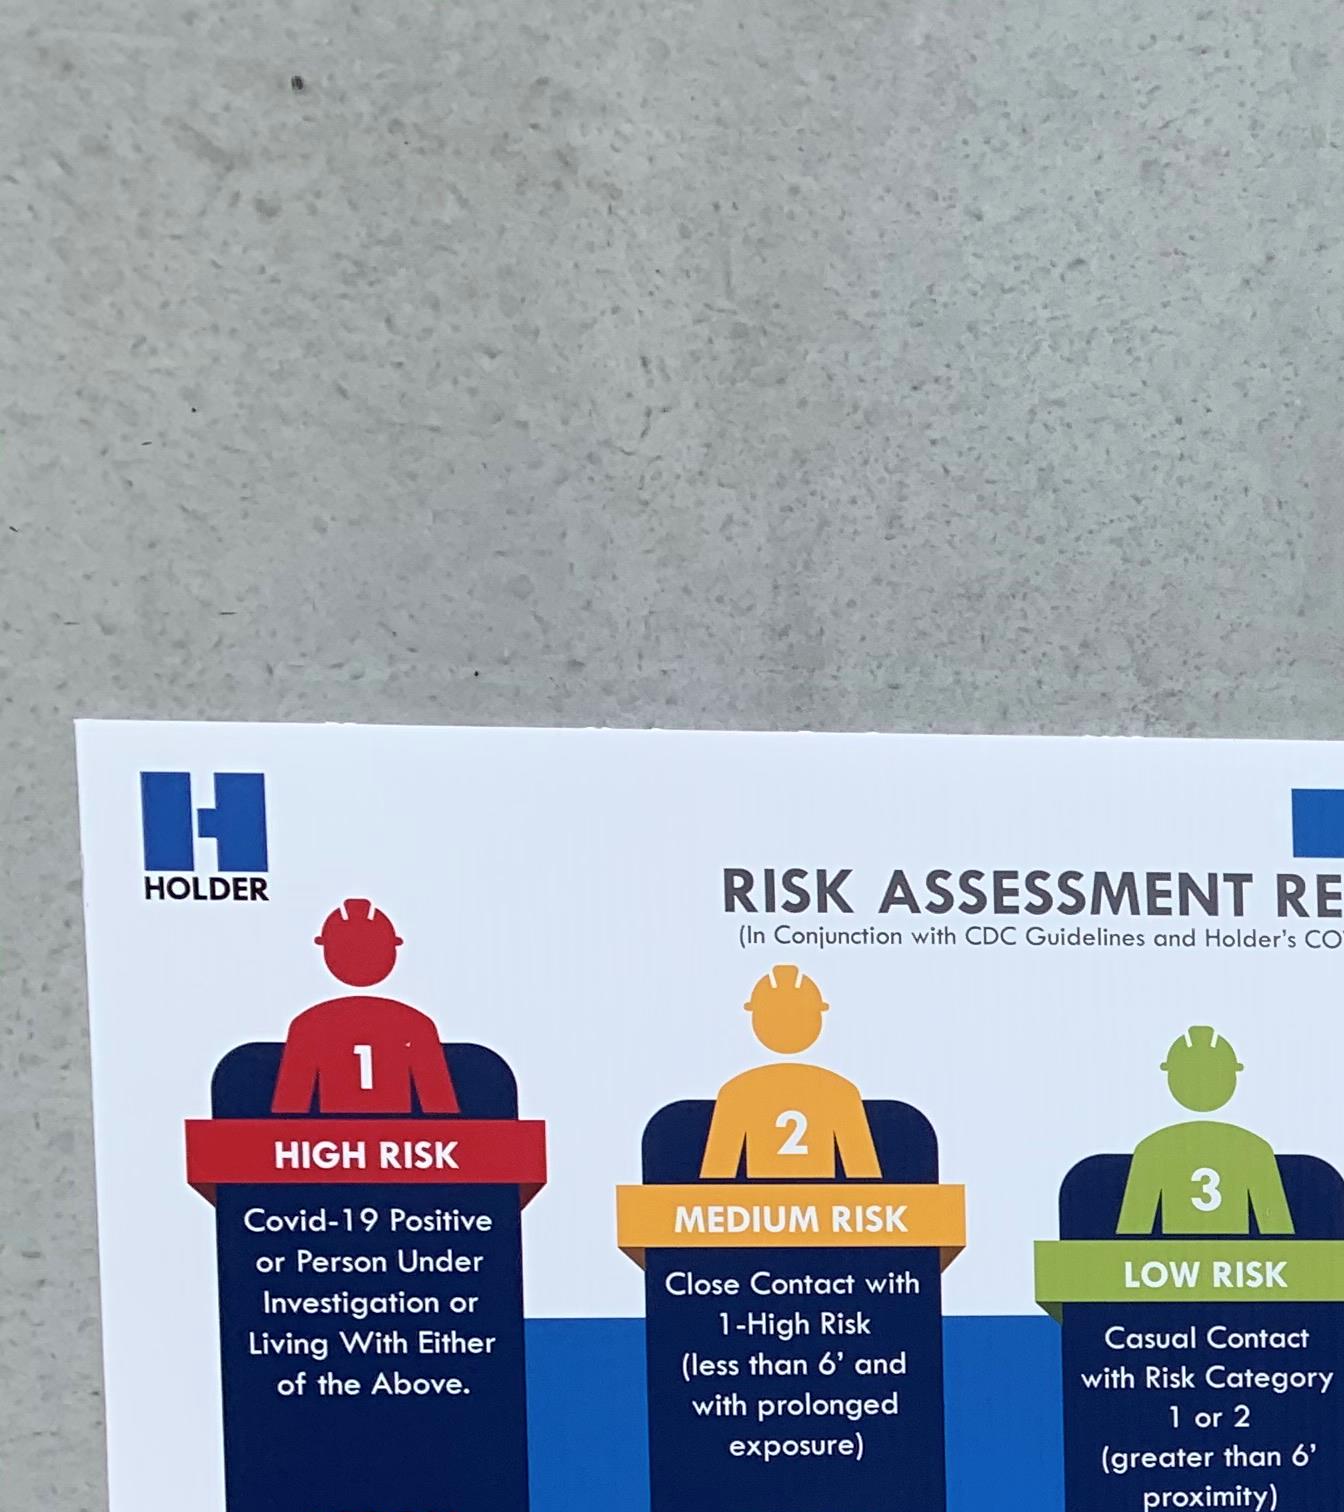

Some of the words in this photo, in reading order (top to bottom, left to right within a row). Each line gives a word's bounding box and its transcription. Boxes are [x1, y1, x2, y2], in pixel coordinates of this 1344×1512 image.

[144, 876, 270, 901] HOLDER
[723, 867, 854, 914] RISK
[878, 869, 1254, 917] ASSESSMENT
[739, 924, 765, 949] (In
[774, 924, 902, 950] Conjunction
[911, 925, 956, 945] with
[965, 925, 1017, 946] CDC
[1025, 926, 1146, 947] Guidelines
[1153, 927, 1196, 948] and
[1205, 928, 1297, 949] Holder’s
[353, 1044, 373, 1090] 1
[775, 1110, 809, 1155] 2
[274, 1140, 366, 1169] HIGH
[379, 1140, 460, 1169] RISK
[1190, 1167, 1222, 1212] 3
[243, 1207, 379, 1233] Covid-19
[390, 1208, 493, 1232] Positive
[674, 1205, 820, 1233] MEDIUM
[832, 1205, 908, 1233] RISK
[255, 1256, 286, 1273] or
[297, 1249, 387, 1273] Person
[398, 1248, 484, 1273] Under
[1124, 1260, 1201, 1288] LOW
[1212, 1260, 1288, 1288] RISK
[665, 1271, 740, 1296] Close
[750, 1271, 856, 1296] Contact
[865, 1270, 920, 1294] with
[264, 1290, 439, 1320] Investigation
[449, 1296, 479, 1313] or
[719, 1311, 810, 1341] 1-High
[821, 1311, 871, 1335] Risk
[1104, 1325, 1196, 1350] Casual
[1206, 1325, 1310, 1349] Contact
[249, 1331, 328, 1361] Living
[338, 1330, 408, 1354] With
[418, 1330, 496, 1354] Either
[682, 1352, 740, 1382] (less
[748, 1352, 808, 1376] than
[818, 1351, 844, 1376] 6’
[854, 1351, 906, 1375] and
[1080, 1365, 1135, 1389] with
[1146, 1365, 1196, 1389] Risk
[1205, 1365, 1334, 1394] Category
[277, 1371, 307, 1396] of
[317, 1371, 361, 1396] the
[370, 1371, 470, 1395] Above.
[692, 1392, 747, 1416] with
[758, 1391, 898, 1422] prolonged
[1169, 1405, 1179, 1428] 1
[1194, 1412, 1223, 1428] or
[1234, 1404, 1250, 1428] 2
[729, 1431, 864, 1462] exposure)
[1102, 1445, 1215, 1475] (greater
[1223, 1444, 1281, 1467] than
[1291, 1443, 1316, 1467] 6’
